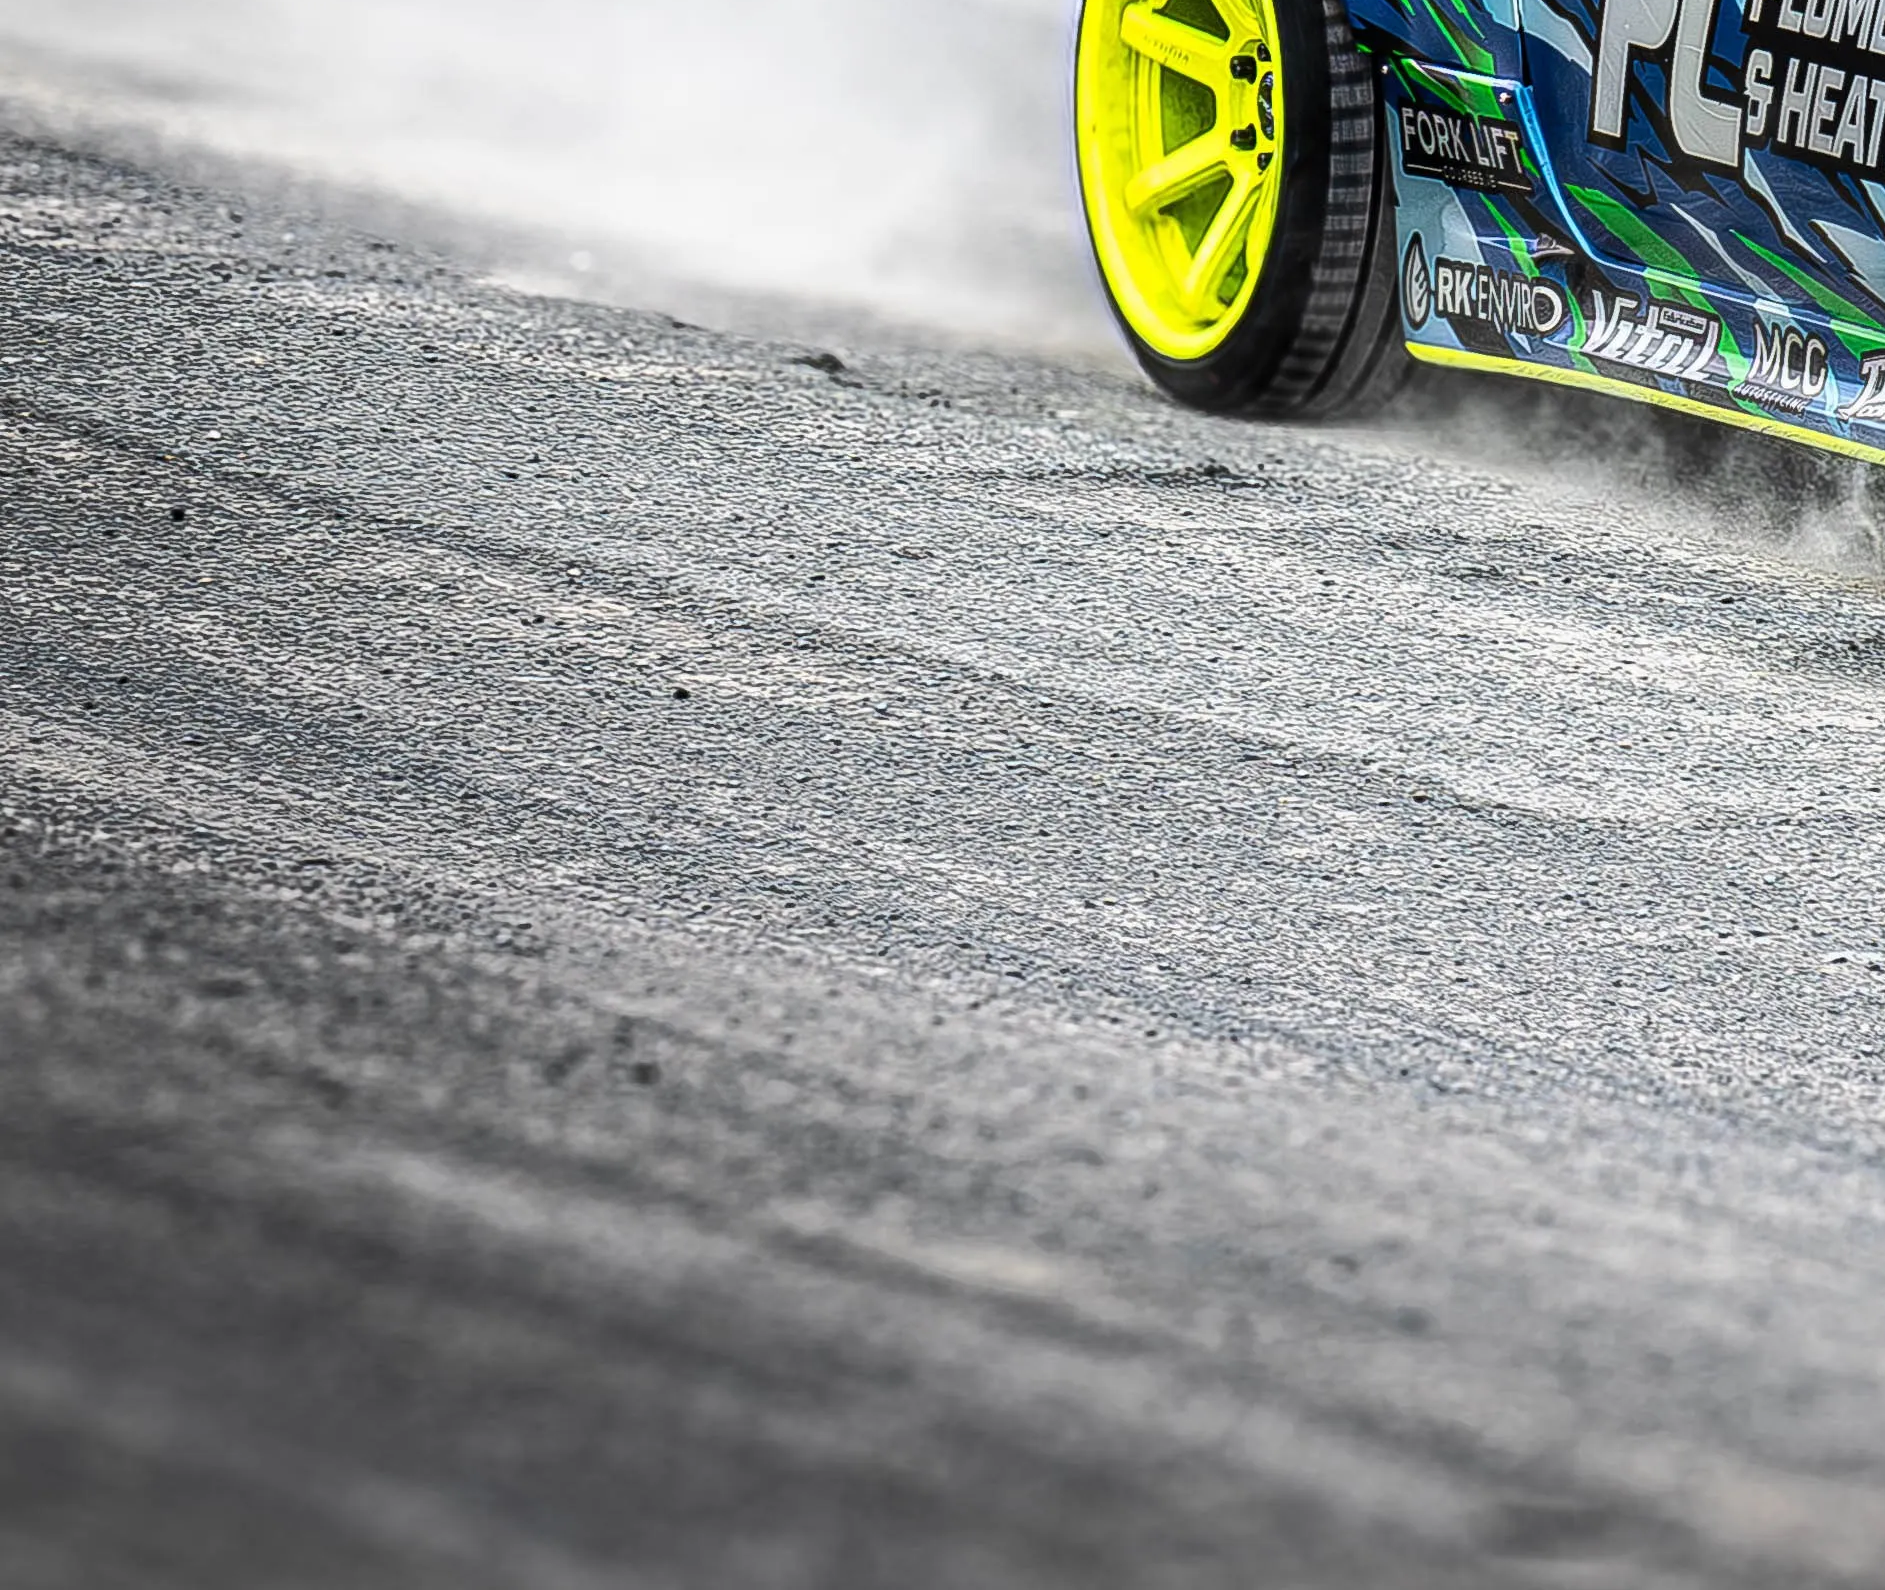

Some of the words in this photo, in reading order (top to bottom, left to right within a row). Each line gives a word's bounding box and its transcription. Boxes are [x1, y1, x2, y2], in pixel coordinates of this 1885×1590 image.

[1401, 107, 1471, 163] FORK
[1469, 121, 1523, 174] LIFT
[1437, 266, 1473, 317] RK
[1477, 273, 1563, 333] ENVIRO
[1749, 322, 1826, 397] MCC
